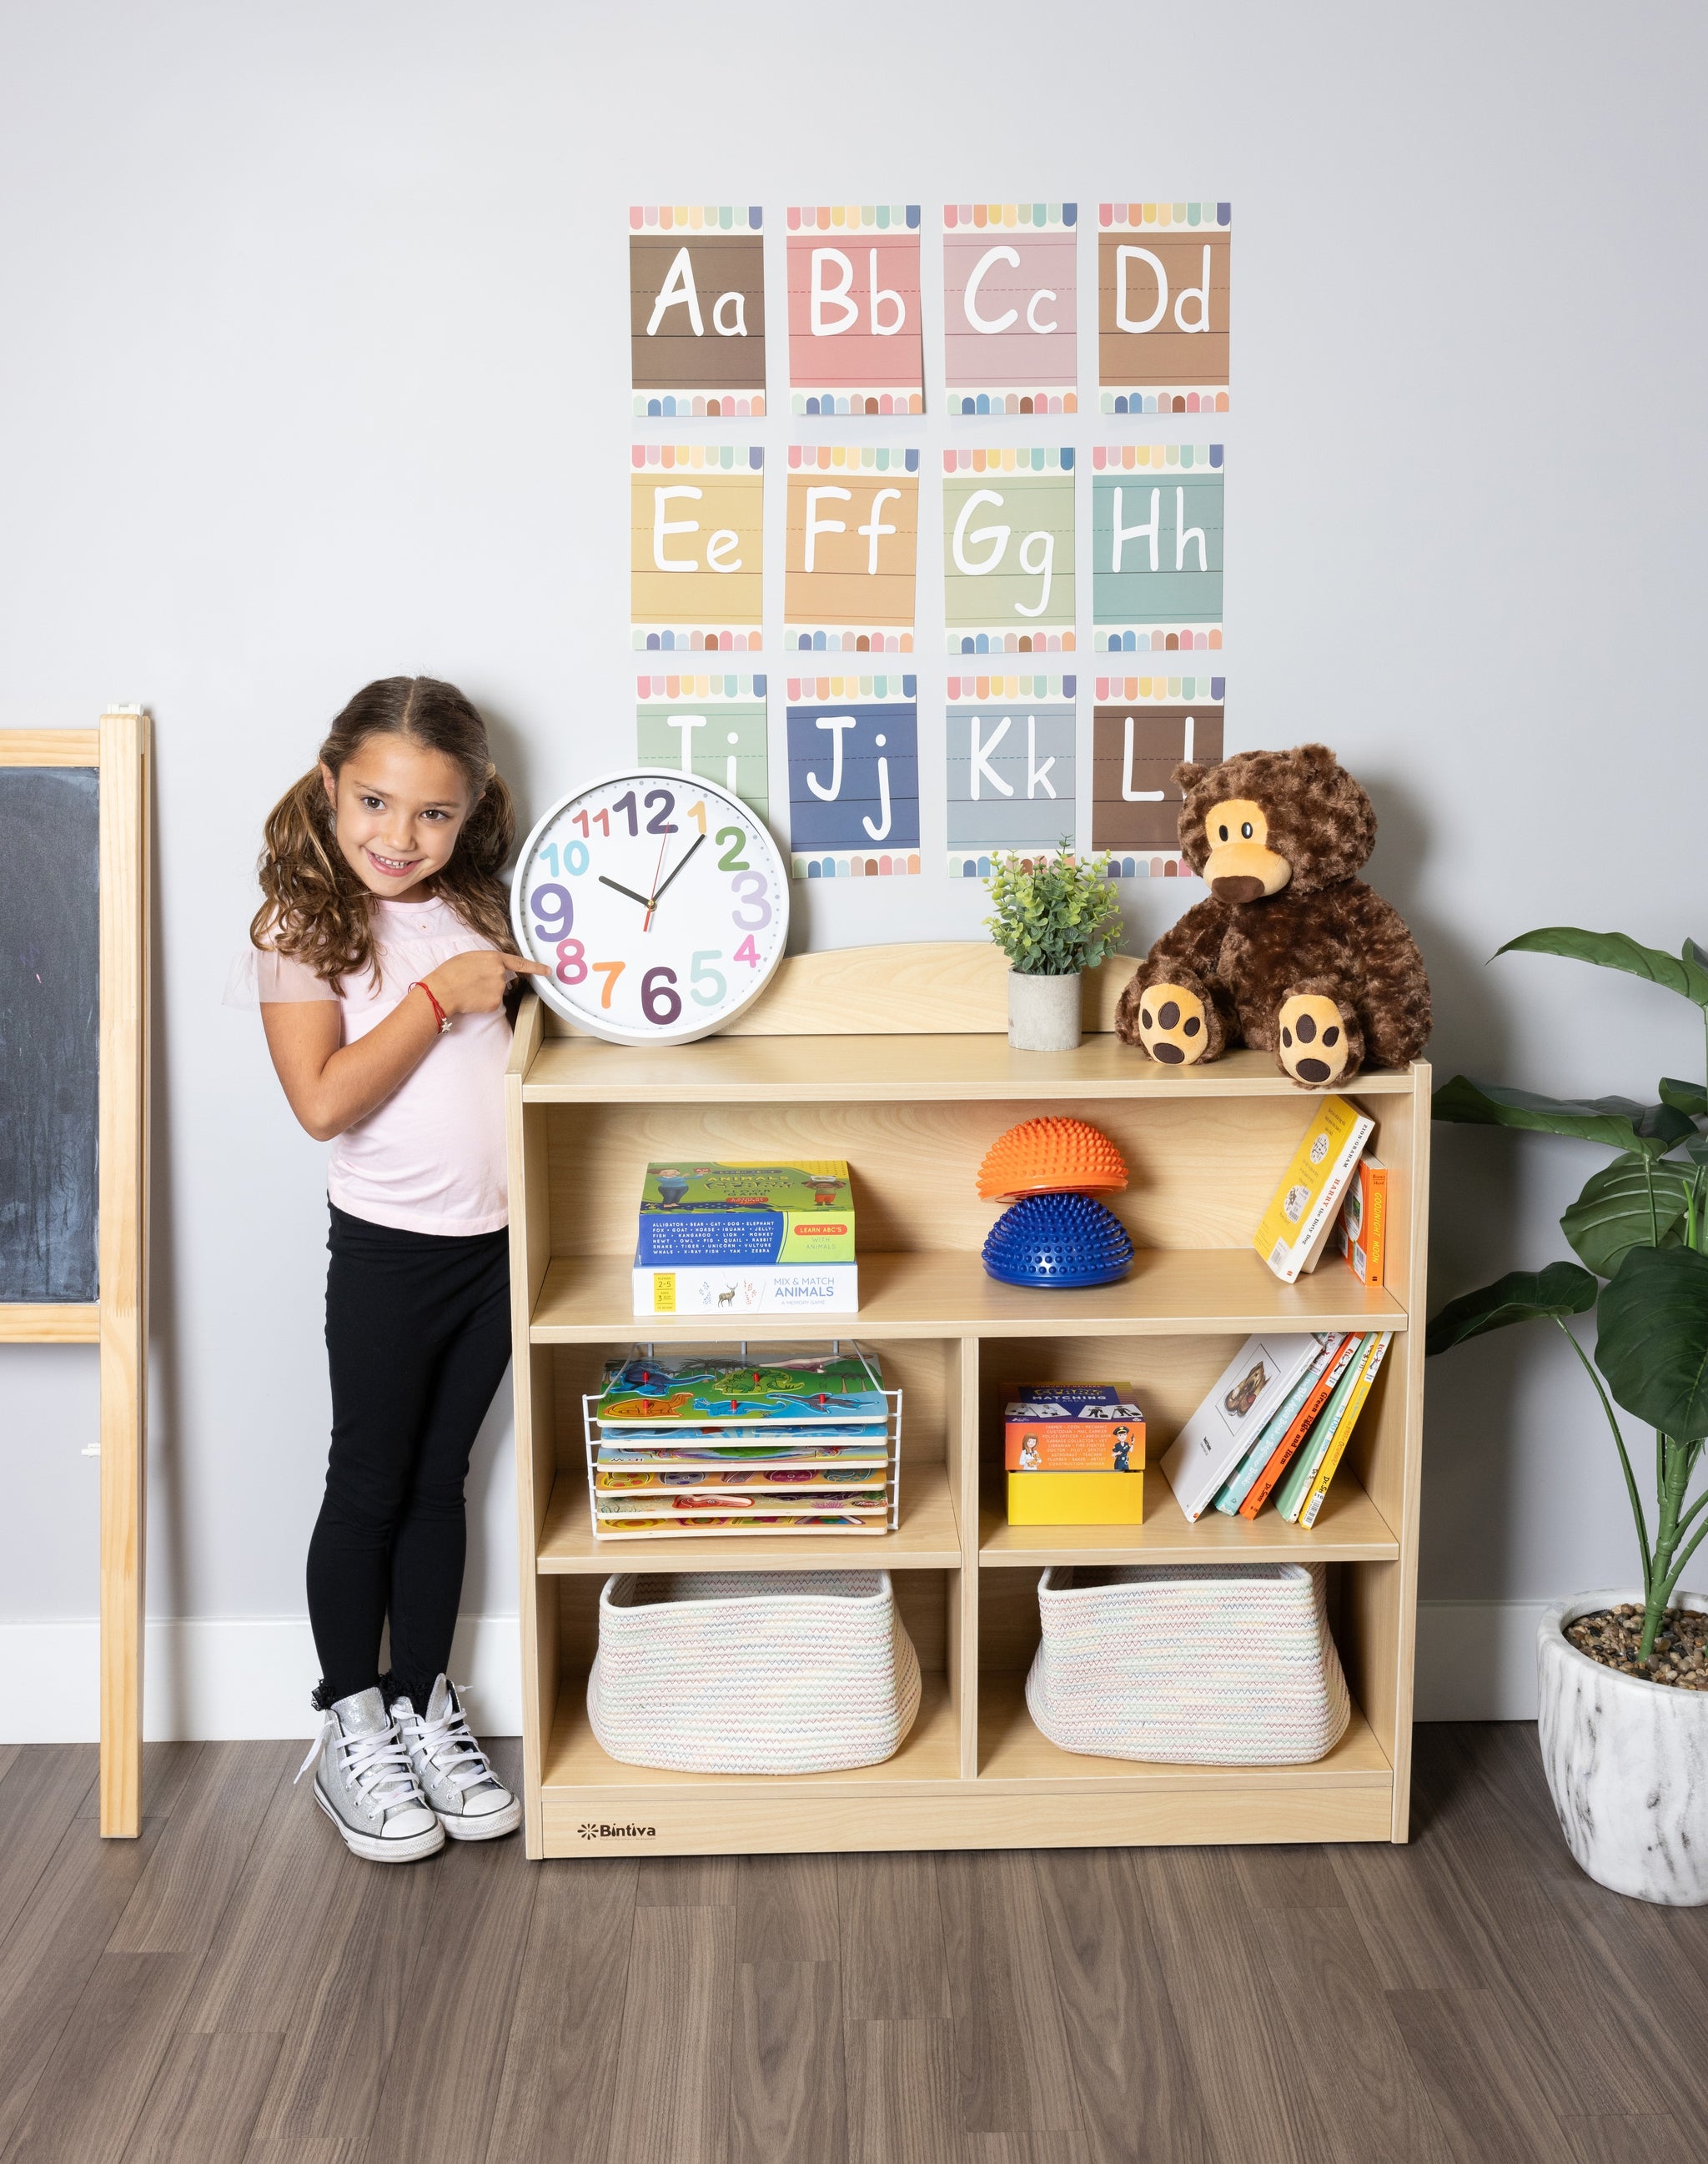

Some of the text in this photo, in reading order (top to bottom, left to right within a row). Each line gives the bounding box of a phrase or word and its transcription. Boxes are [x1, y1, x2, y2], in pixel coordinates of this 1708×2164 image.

[646, 247, 748, 336] Aa
[811, 249, 906, 336] Bb
[963, 246, 1057, 334] Cc
[1116, 245, 1211, 333] Dd
[653, 485, 742, 573] Ee
[805, 487, 902, 575] Ff
[1113, 486, 1208, 573] Hh
[952, 490, 1054, 617] Gg
[806, 715, 892, 841] Jj
[970, 715, 1057, 801] Kk
[571, 808, 610, 838] 11
[612, 789, 679, 837] 12
[687, 801, 707, 835] 1
[539, 840, 590, 877] 10
[715, 826, 750, 871] 2
[530, 883, 574, 942] 9
[731, 871, 772, 931] 3
[555, 938, 588, 985] 8
[733, 934, 761, 968] 4
[591, 961, 625, 1009] 7
[640, 967, 682, 1025] 6
[690, 950, 727, 1007] 5
[1324, 1179, 1340, 1207] HARRY
[1309, 1219, 1319, 1233] Dirty
[1372, 1240, 1380, 1263] MOON
[775, 1286, 834, 1297] ANIMALS
[1282, 1401, 1297, 1419] Aqua
[1294, 1386, 1308, 1402] BIG
[1312, 1392, 1328, 1413] Green
[1273, 1419, 1286, 1435] Book
[1292, 1433, 1301, 1448] and
[1300, 1416, 1314, 1433] Eggs
[1280, 1449, 1293, 1465] Ham
[600, 1823, 656, 1837] Bintiva
